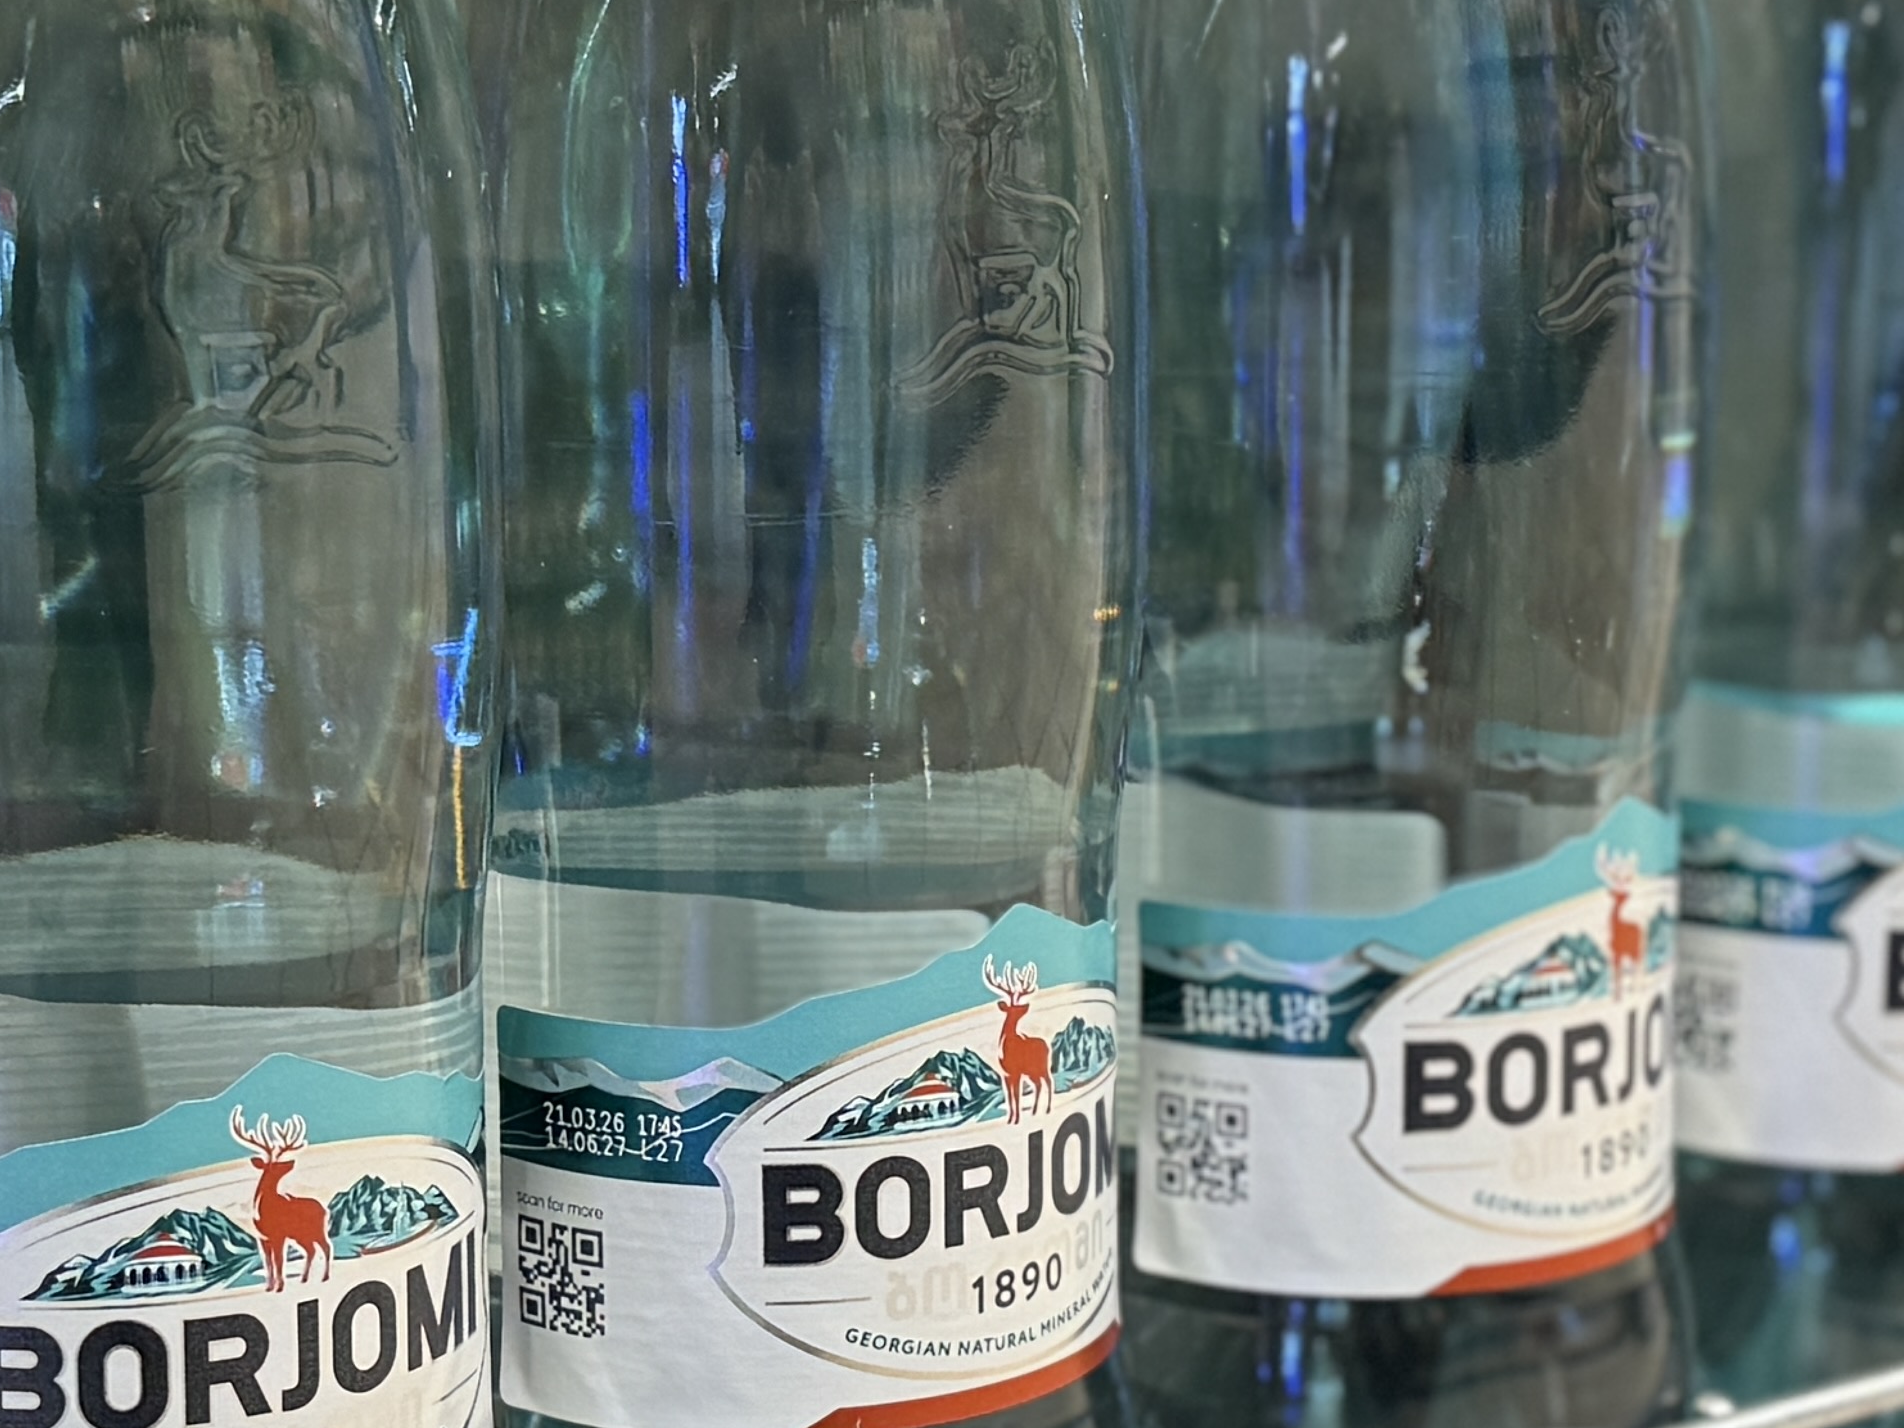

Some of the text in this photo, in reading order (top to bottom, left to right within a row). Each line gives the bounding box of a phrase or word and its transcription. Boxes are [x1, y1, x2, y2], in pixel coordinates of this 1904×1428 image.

[1403, 995, 1666, 1134] BORJO
[543, 1101, 625, 1133] 21.03.26
[545, 1125, 684, 1163] 14.06.27 L27
[567, 1202, 604, 1221] more
[762, 1095, 1116, 1268] BORJOM
[971, 1252, 1062, 1315] 1890
[845, 1327, 952, 1357] GEORGIAN
[957, 1326, 1037, 1357] NATURAL
[1040, 1288, 1092, 1338] MINERAL
